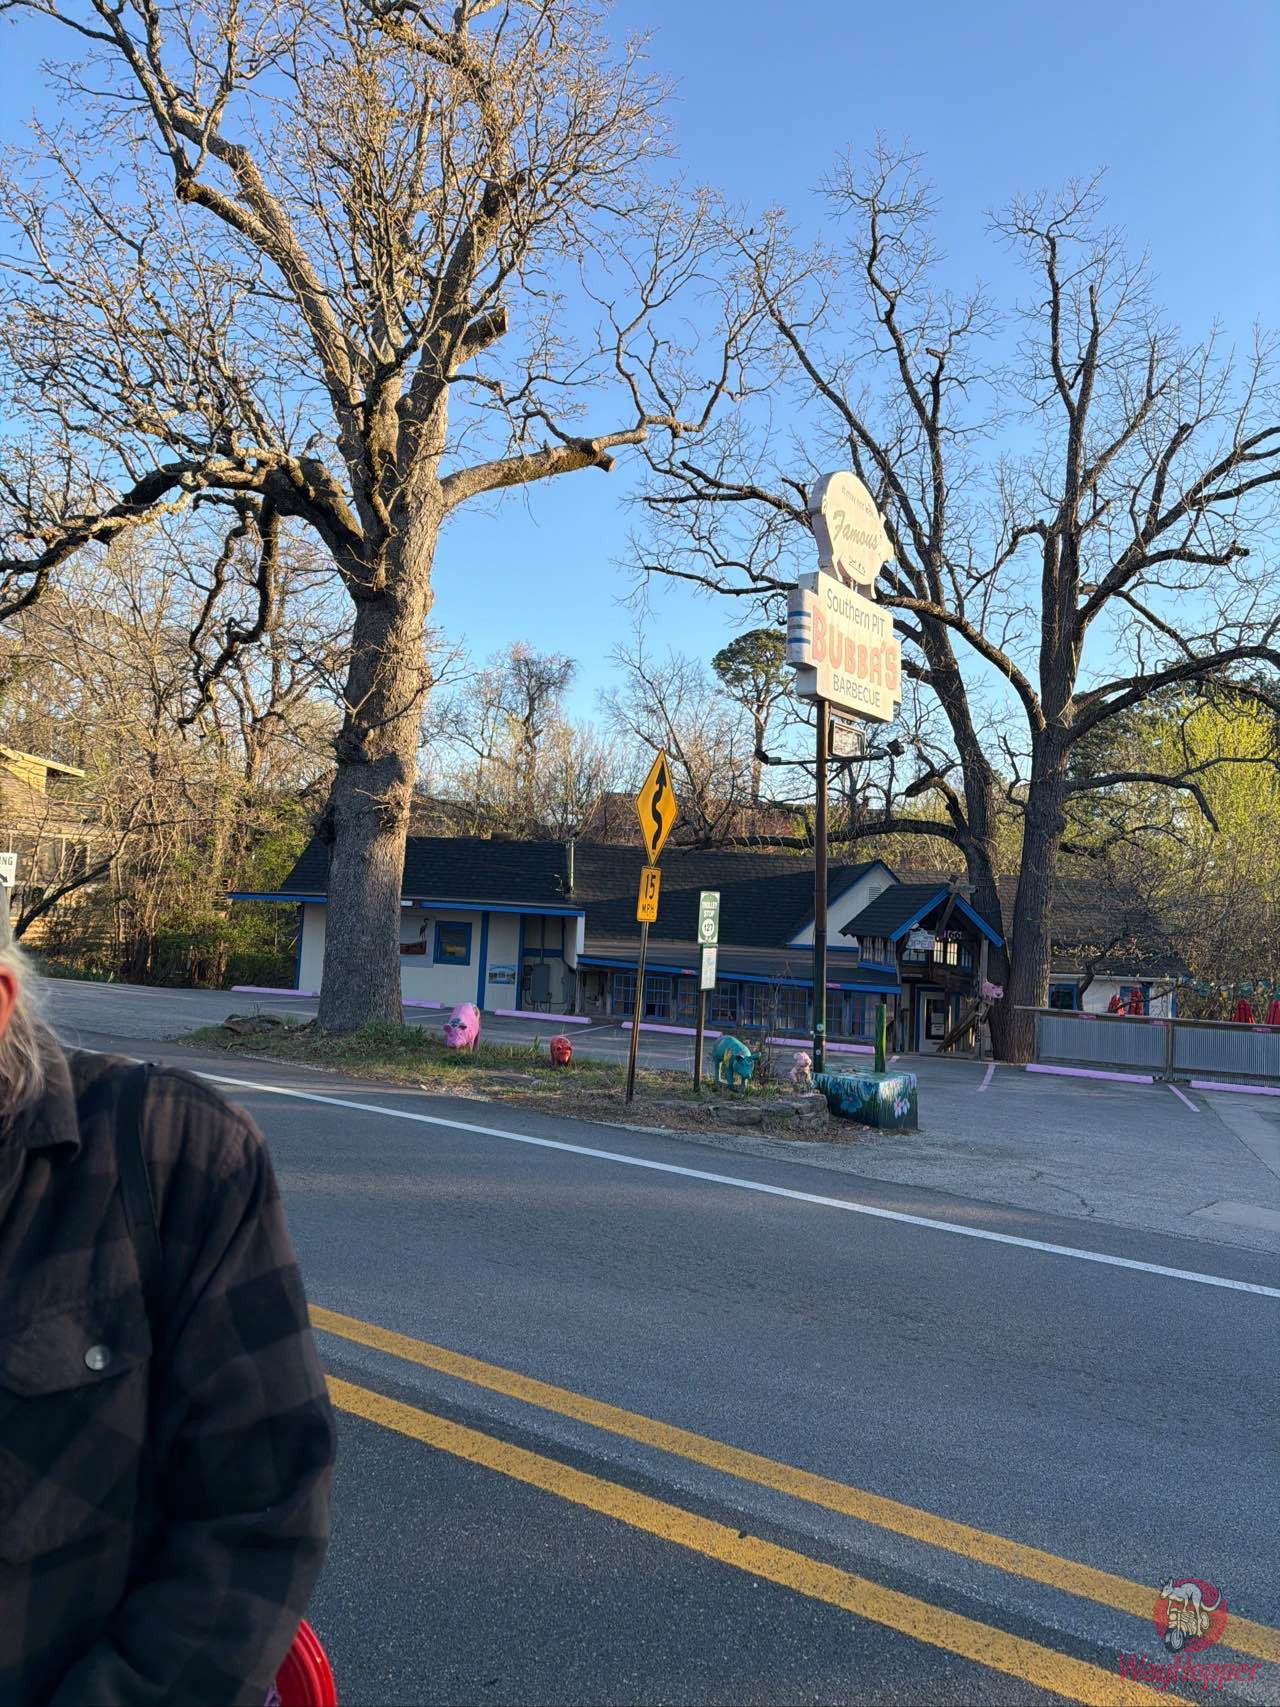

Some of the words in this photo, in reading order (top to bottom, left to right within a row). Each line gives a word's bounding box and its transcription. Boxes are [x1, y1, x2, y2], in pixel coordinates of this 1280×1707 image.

[832, 510, 879, 550] Famous
[826, 587, 870, 627] Southern
[871, 615, 885, 637] PIT
[811, 604, 897, 690] BUBBA'S
[833, 675, 881, 708] BARBECUE
[645, 873, 656, 900] 15
[642, 903, 655, 913] MPH
